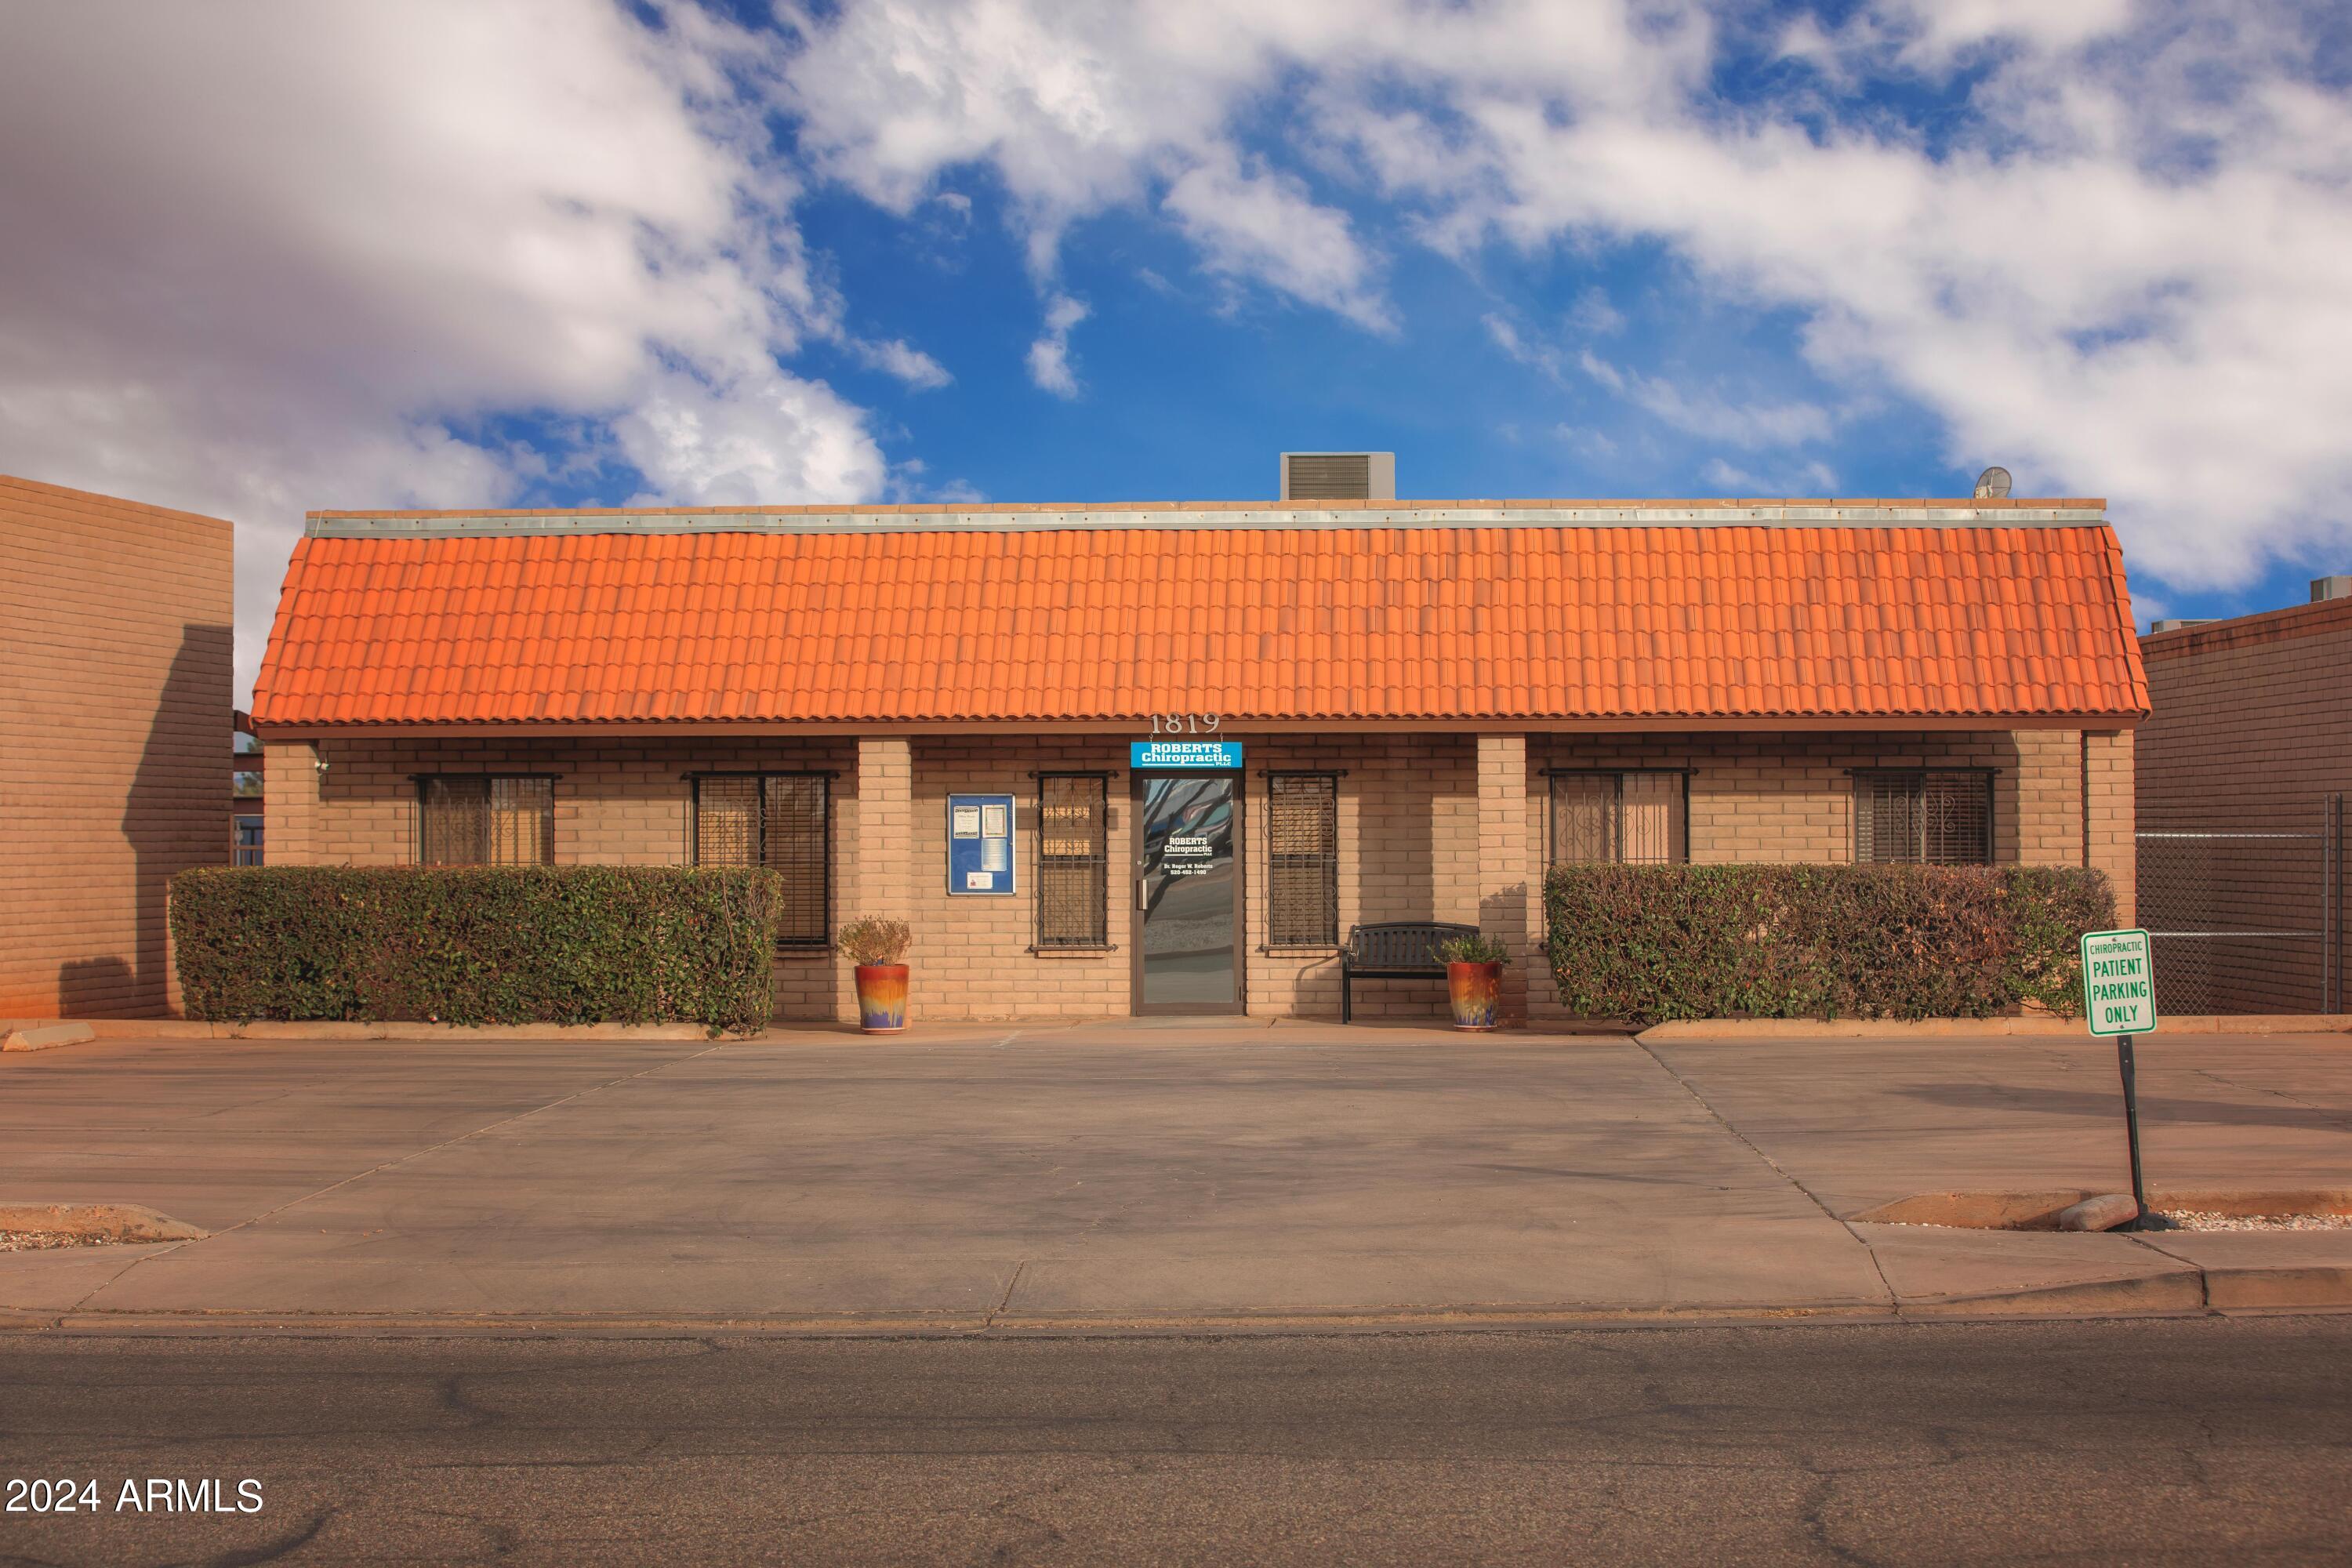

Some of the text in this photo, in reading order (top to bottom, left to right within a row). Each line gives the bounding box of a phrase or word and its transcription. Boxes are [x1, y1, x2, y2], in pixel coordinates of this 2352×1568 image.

[1151, 713, 1220, 733] 1819
[1151, 743, 1222, 753] ROBERTS
[1142, 753, 1232, 764] Chiropractic
[1164, 845, 1213, 854] Chiropractic
[2090, 941, 2143, 955] CHIROPRACTIC
[2092, 957, 2142, 978] PATIENT
[2092, 981, 2147, 1001] PARKING
[2105, 1004, 2138, 1023] ONLY
